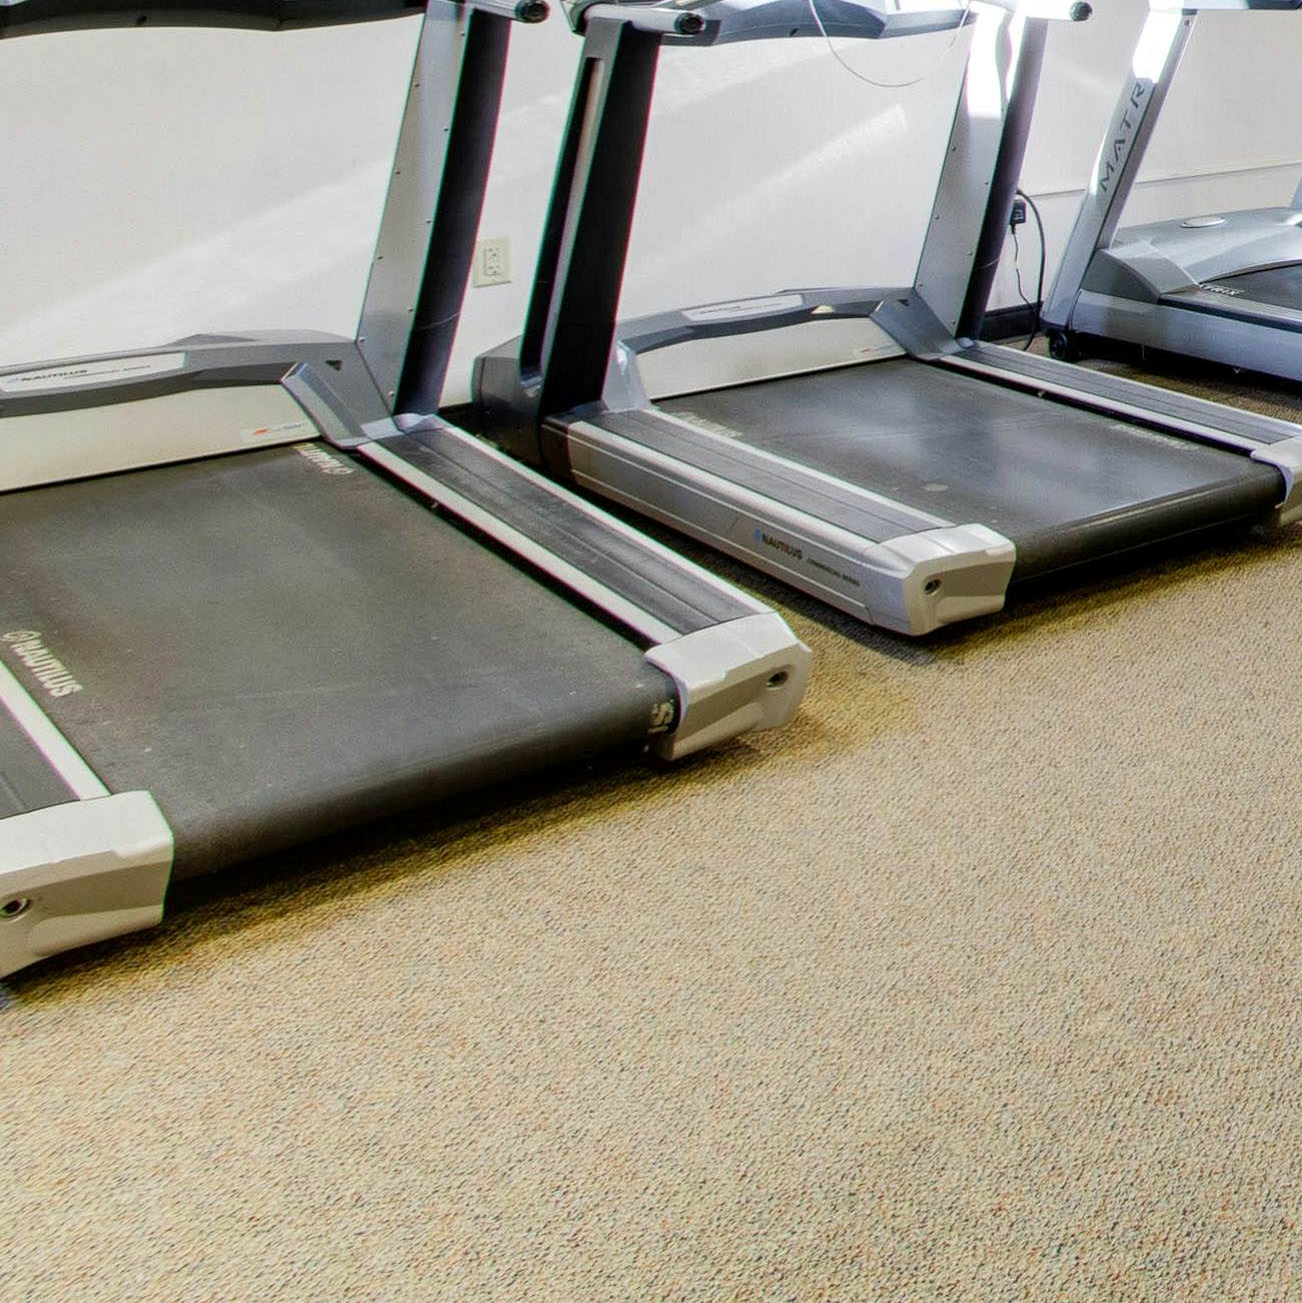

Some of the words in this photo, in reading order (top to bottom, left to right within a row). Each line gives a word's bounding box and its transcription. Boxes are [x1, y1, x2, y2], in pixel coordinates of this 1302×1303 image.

[1100, 81, 1145, 192] MATR
[762, 532, 802, 560] NAUTILUS
[10, 638, 84, 698] NAUTILUS
